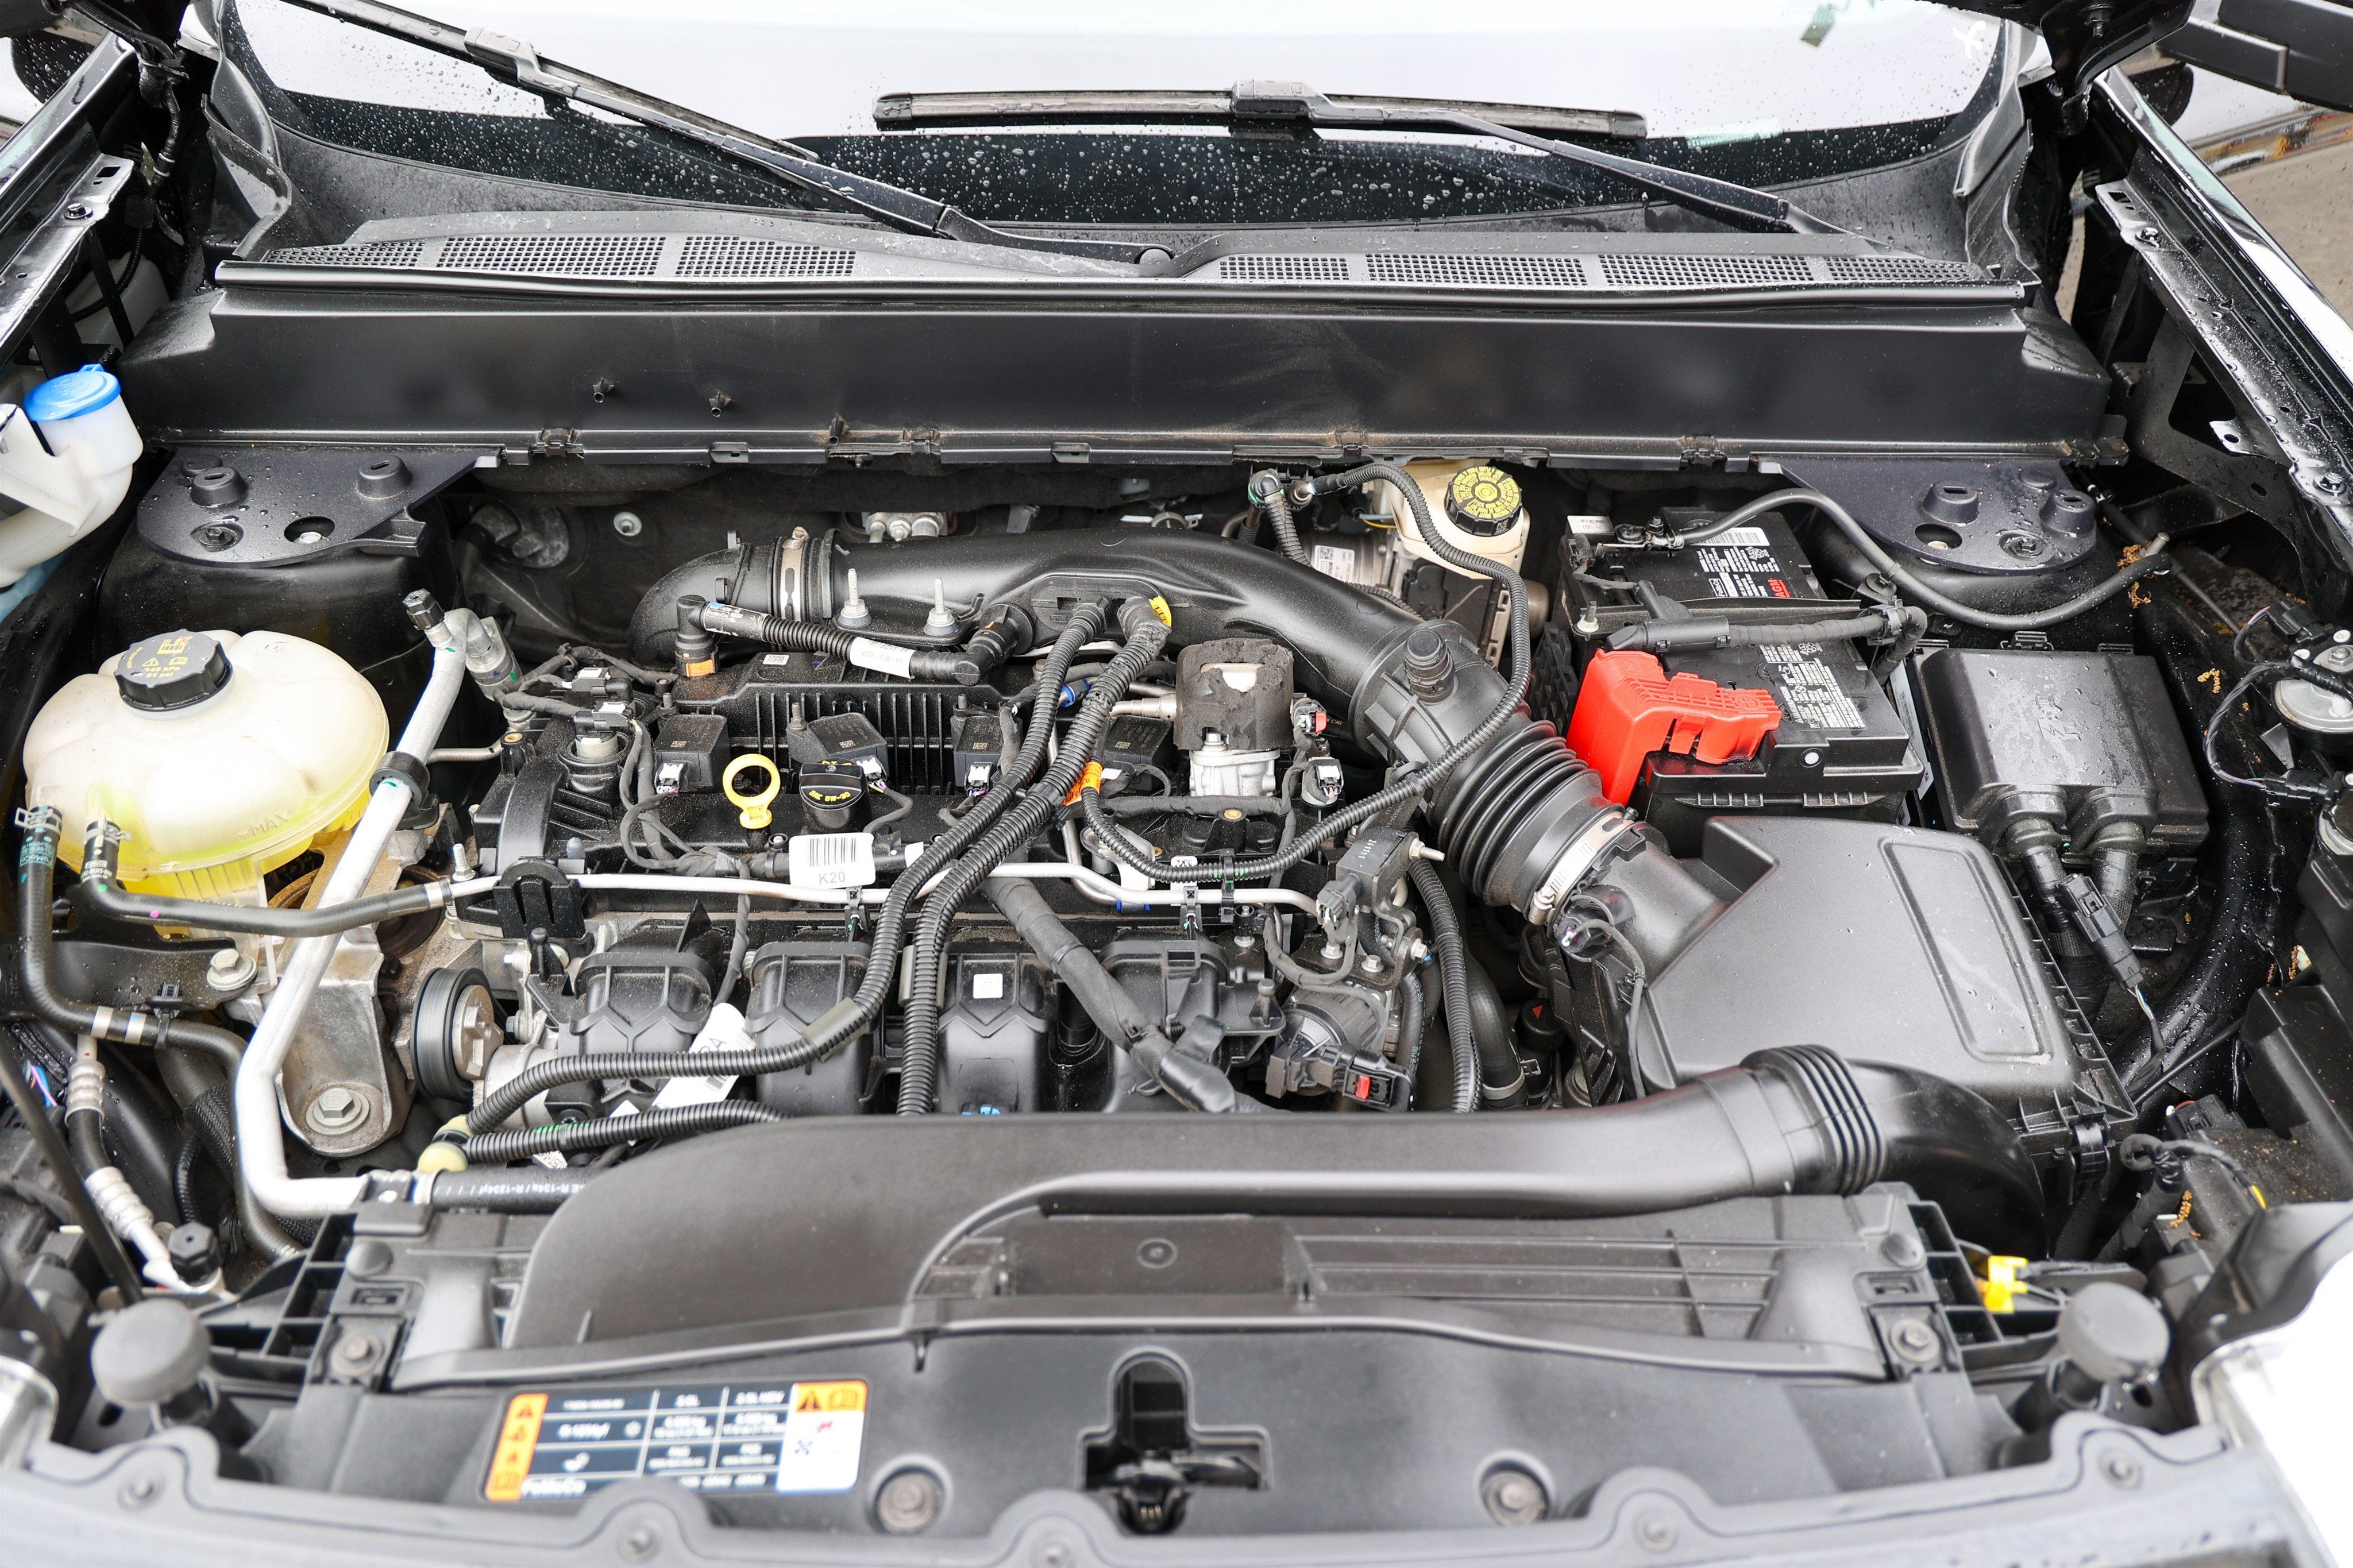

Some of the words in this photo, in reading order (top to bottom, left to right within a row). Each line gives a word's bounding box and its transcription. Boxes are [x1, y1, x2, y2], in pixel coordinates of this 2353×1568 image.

[1766, 579, 1786, 597] AGM
[707, 611, 728, 619] FoMoCo
[809, 790, 823, 800] SAE
[824, 791, 851, 802] 5W-30
[249, 814, 290, 836] MAX
[819, 871, 847, 885] K20
